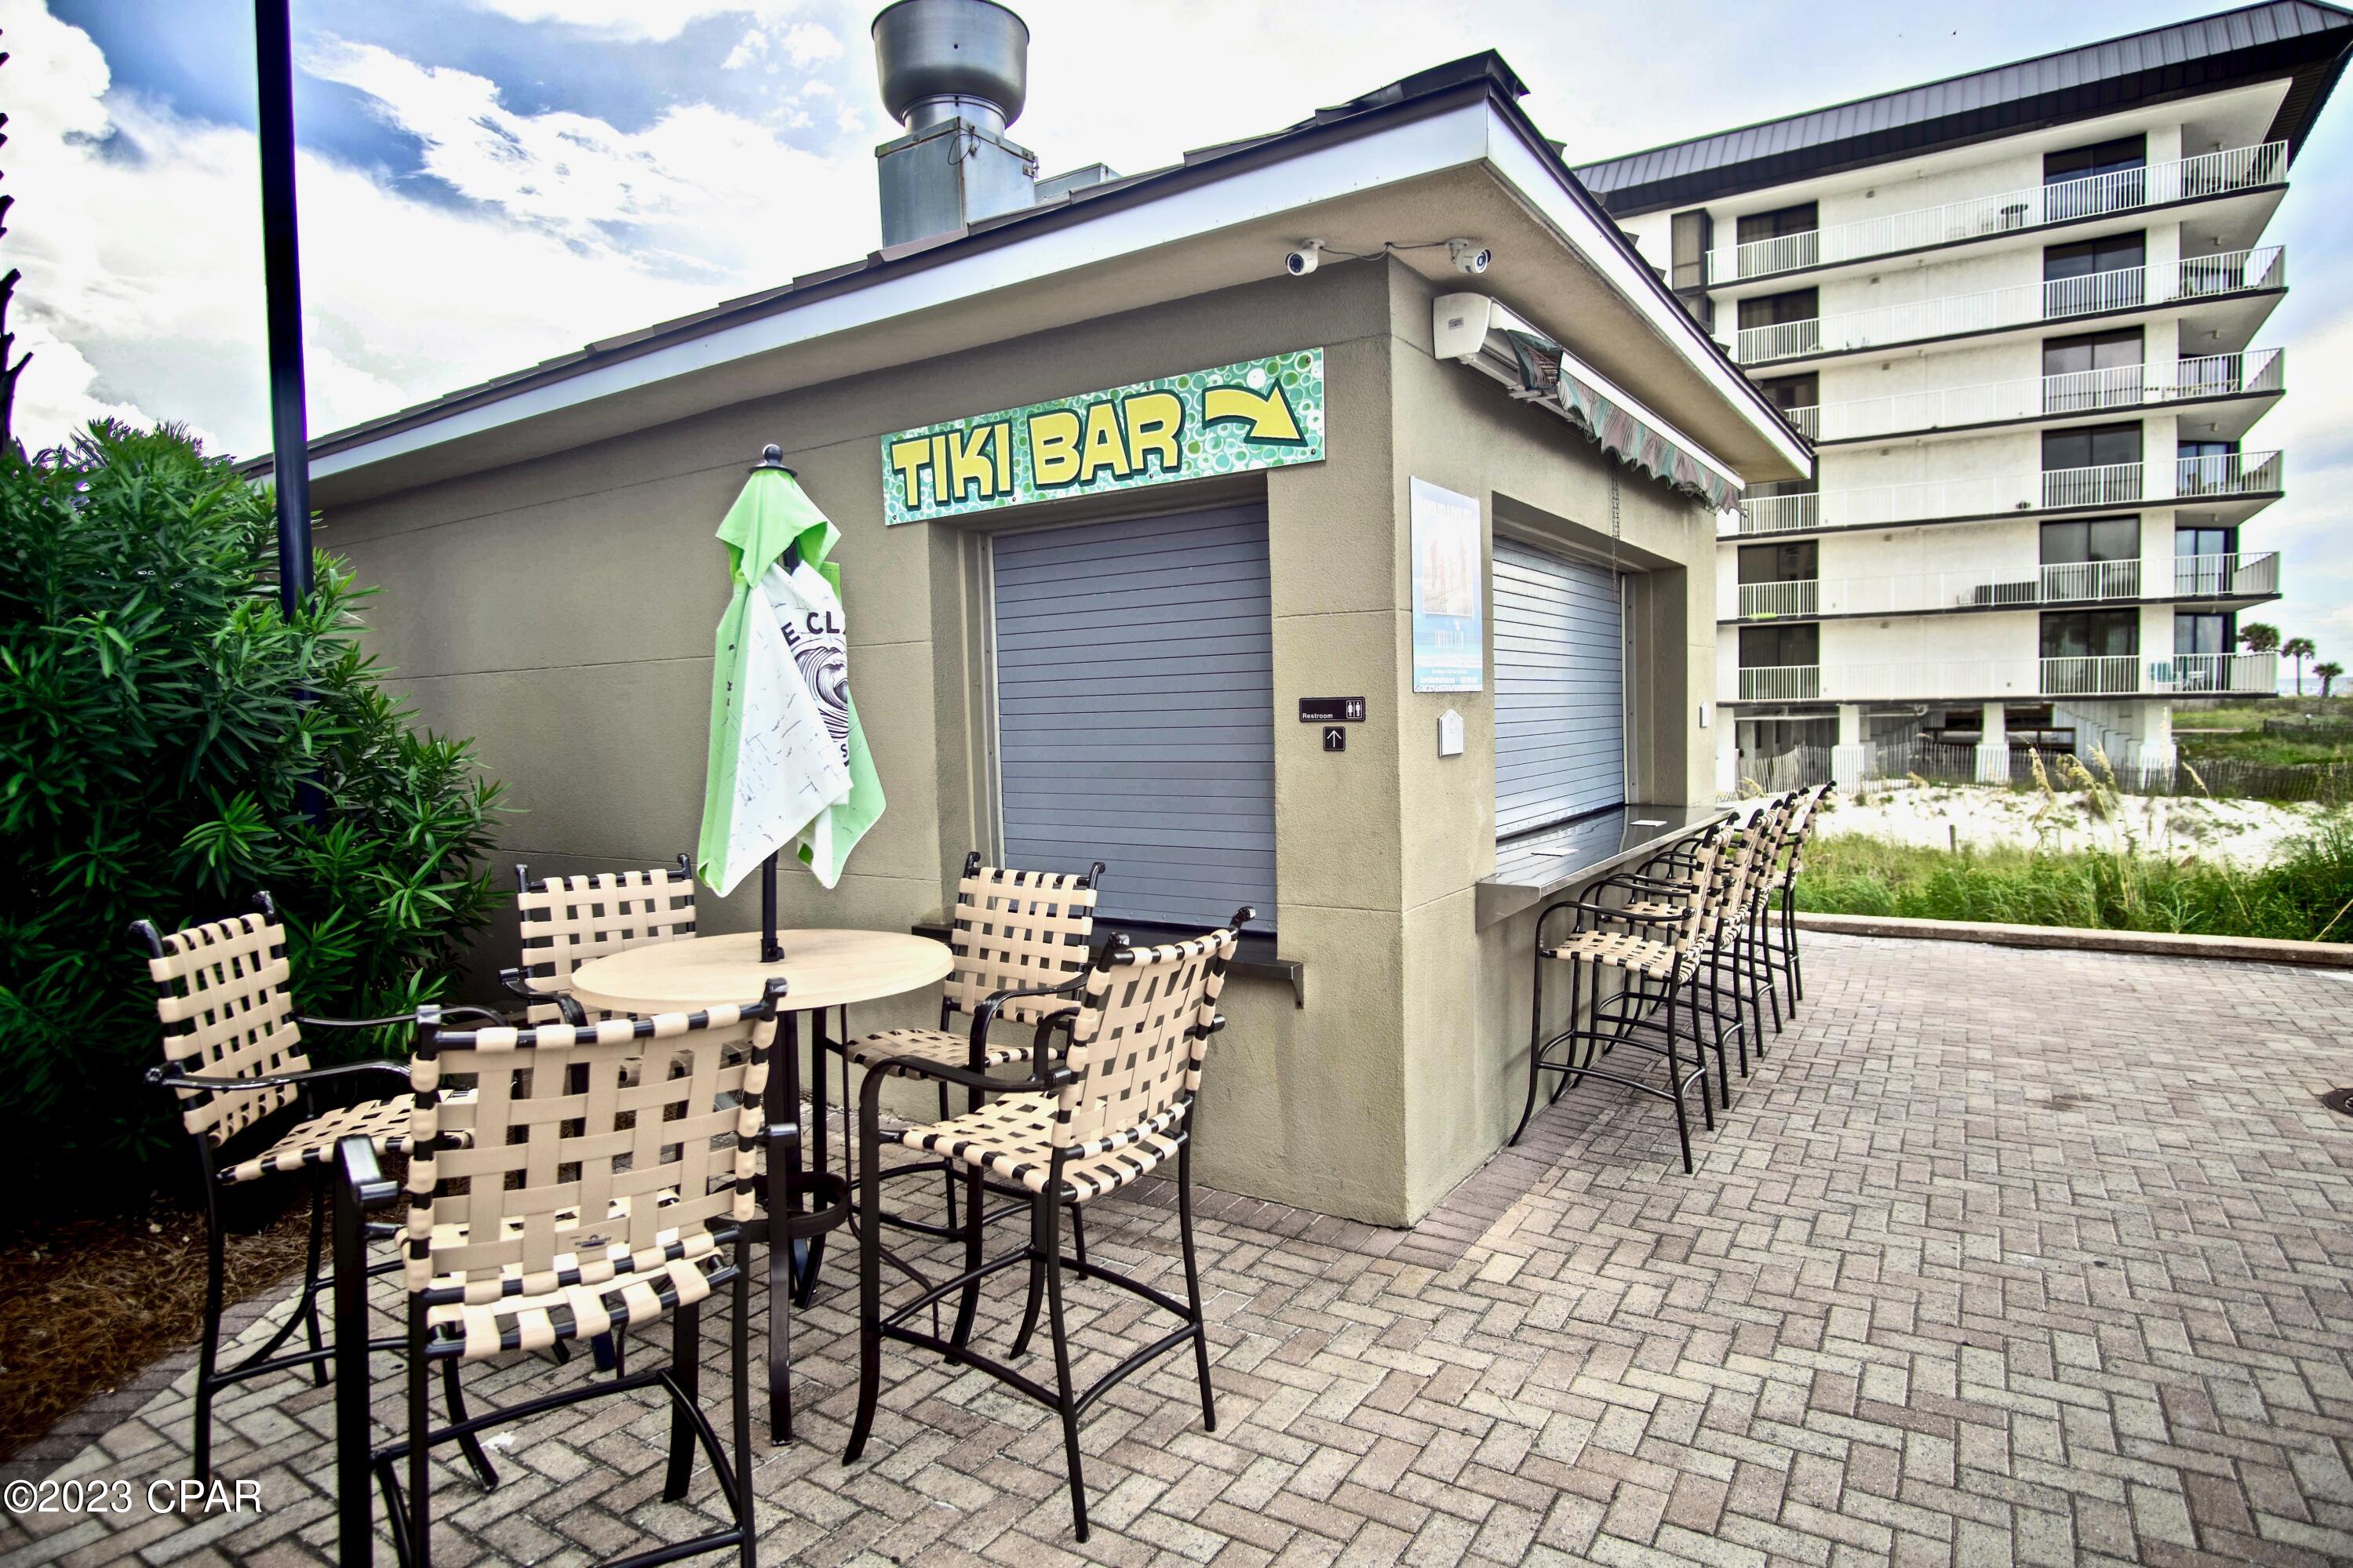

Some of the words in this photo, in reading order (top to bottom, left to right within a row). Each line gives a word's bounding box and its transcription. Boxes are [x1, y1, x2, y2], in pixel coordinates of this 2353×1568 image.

[890, 419, 1014, 508] TIKI
[1027, 389, 1186, 488] BAR
[781, 622, 800, 646] E
[807, 611, 845, 635] CL
